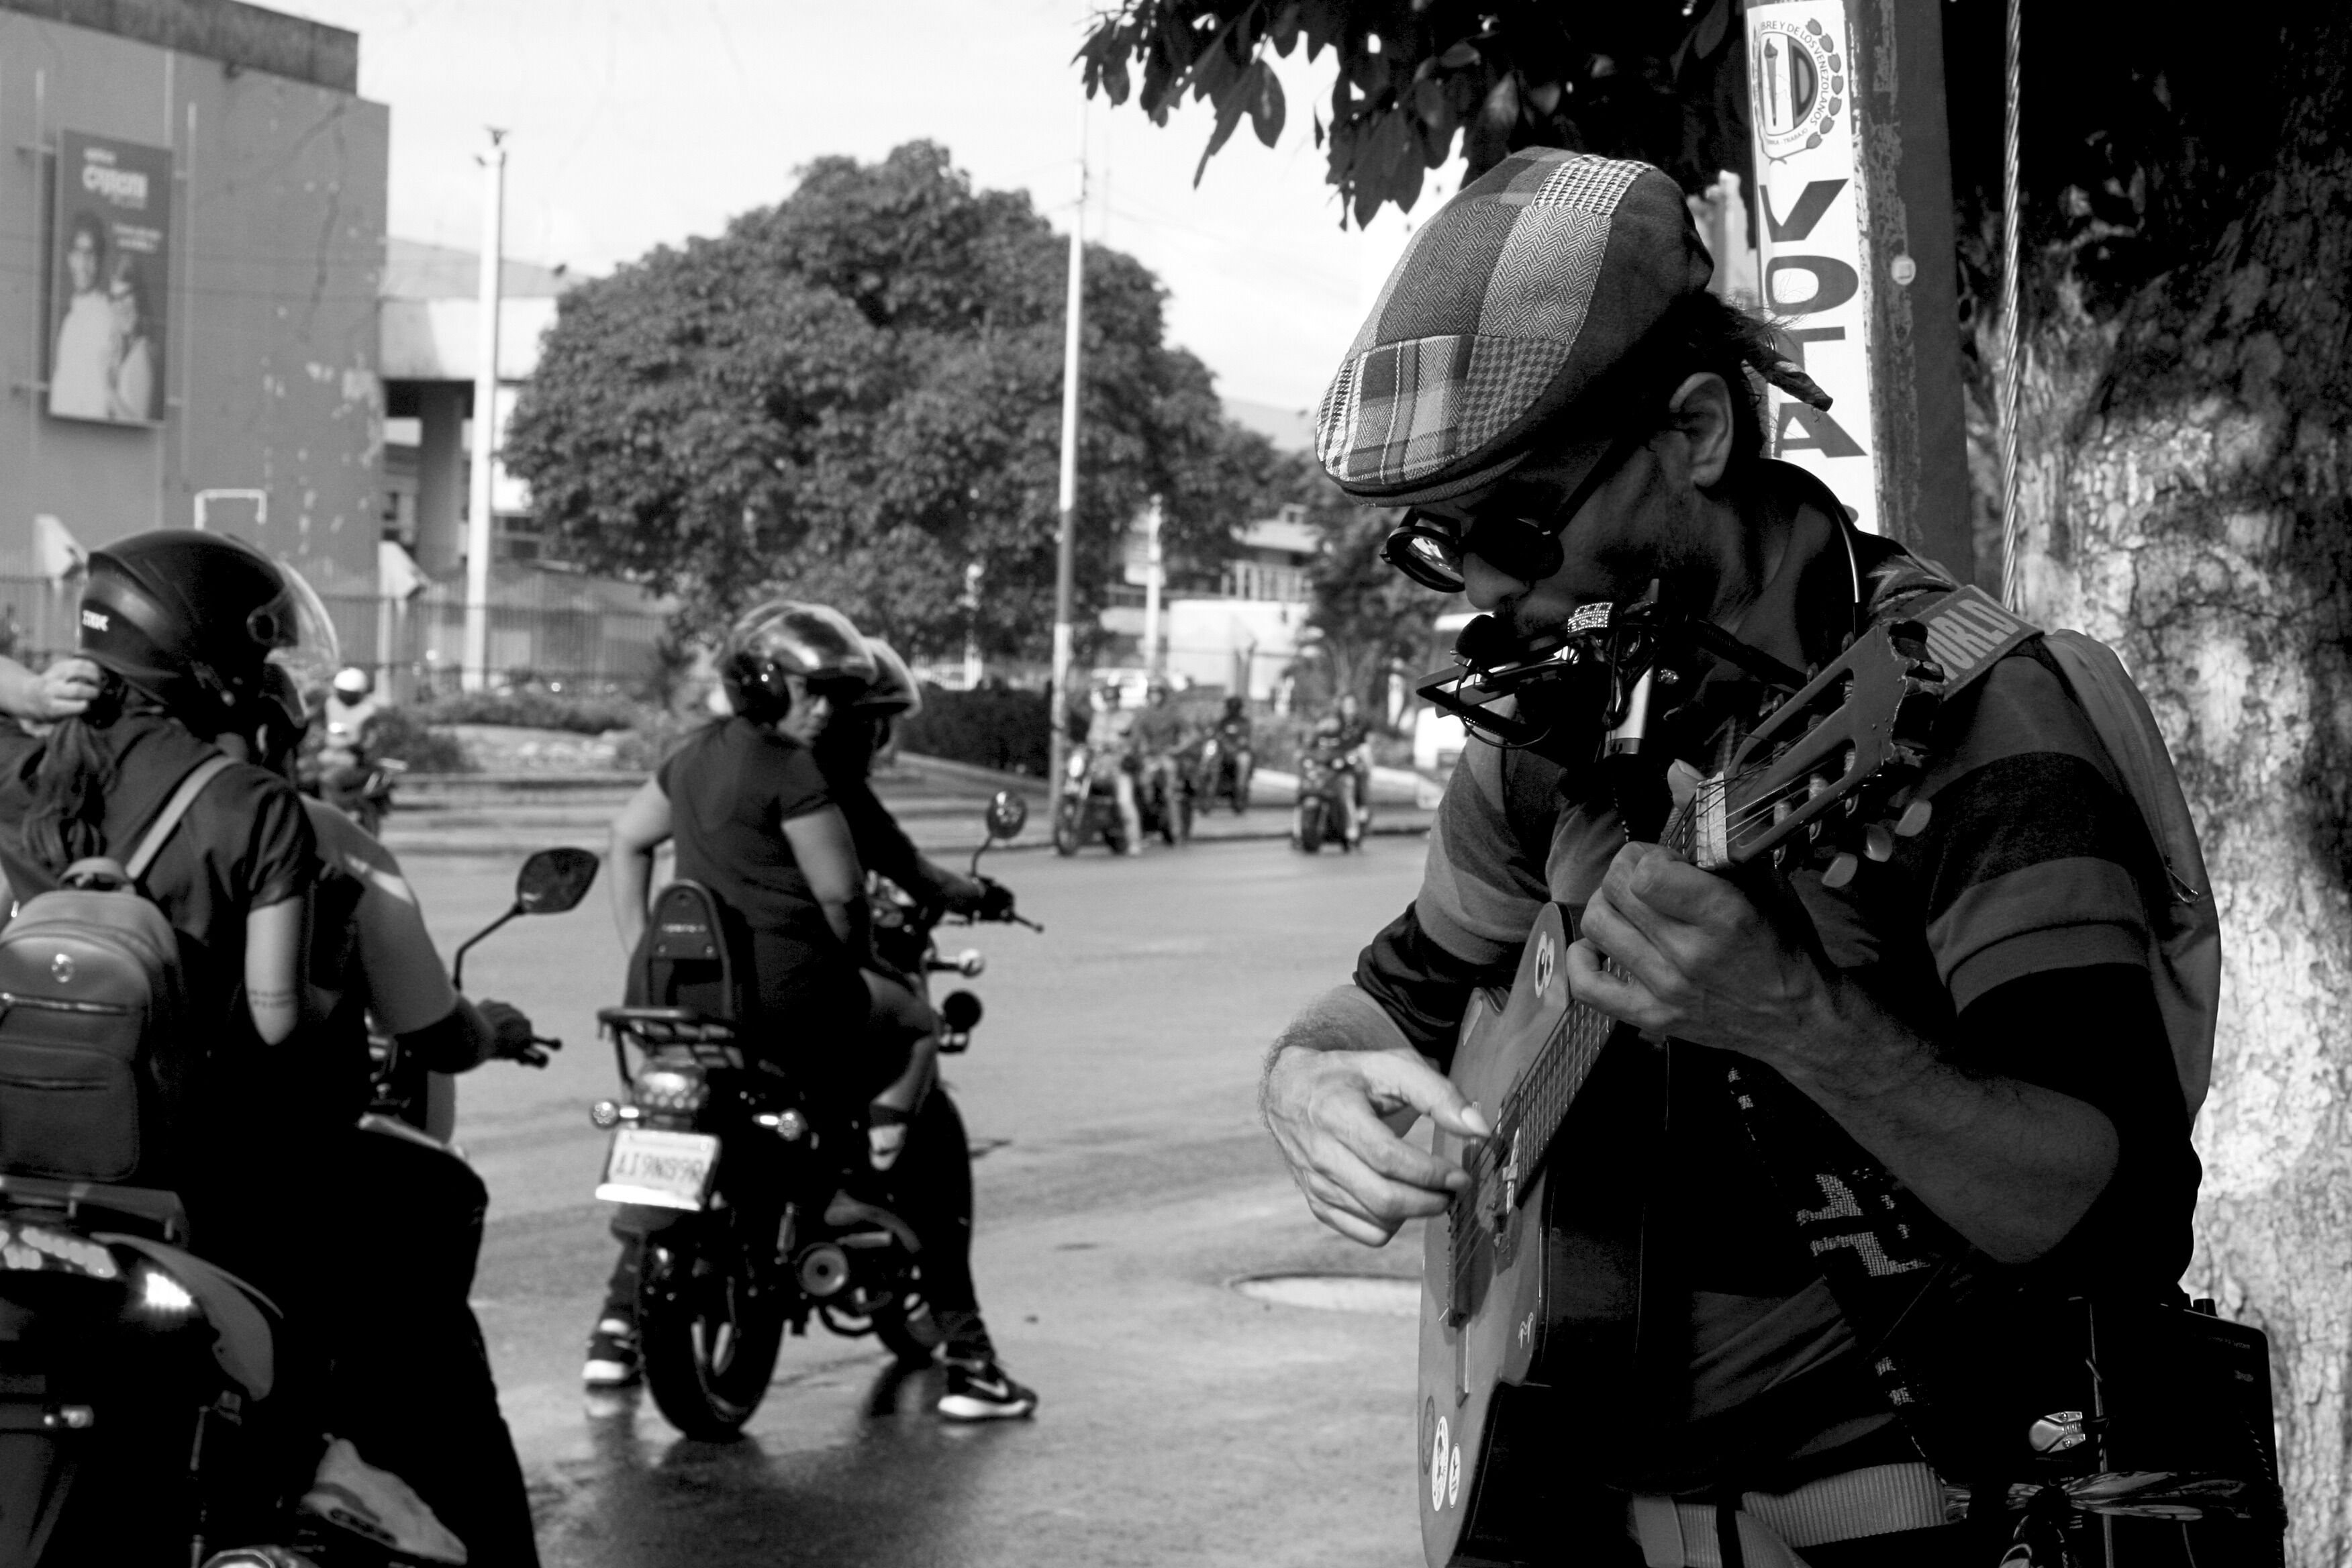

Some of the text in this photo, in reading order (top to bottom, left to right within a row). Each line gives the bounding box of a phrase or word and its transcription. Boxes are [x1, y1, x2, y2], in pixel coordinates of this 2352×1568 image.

[1779, 21, 1785, 30] Y
[1787, 23, 1801, 36] DE
[1800, 30, 1817, 48] LOS
[1810, 48, 1830, 126] VENEZOLANOS
